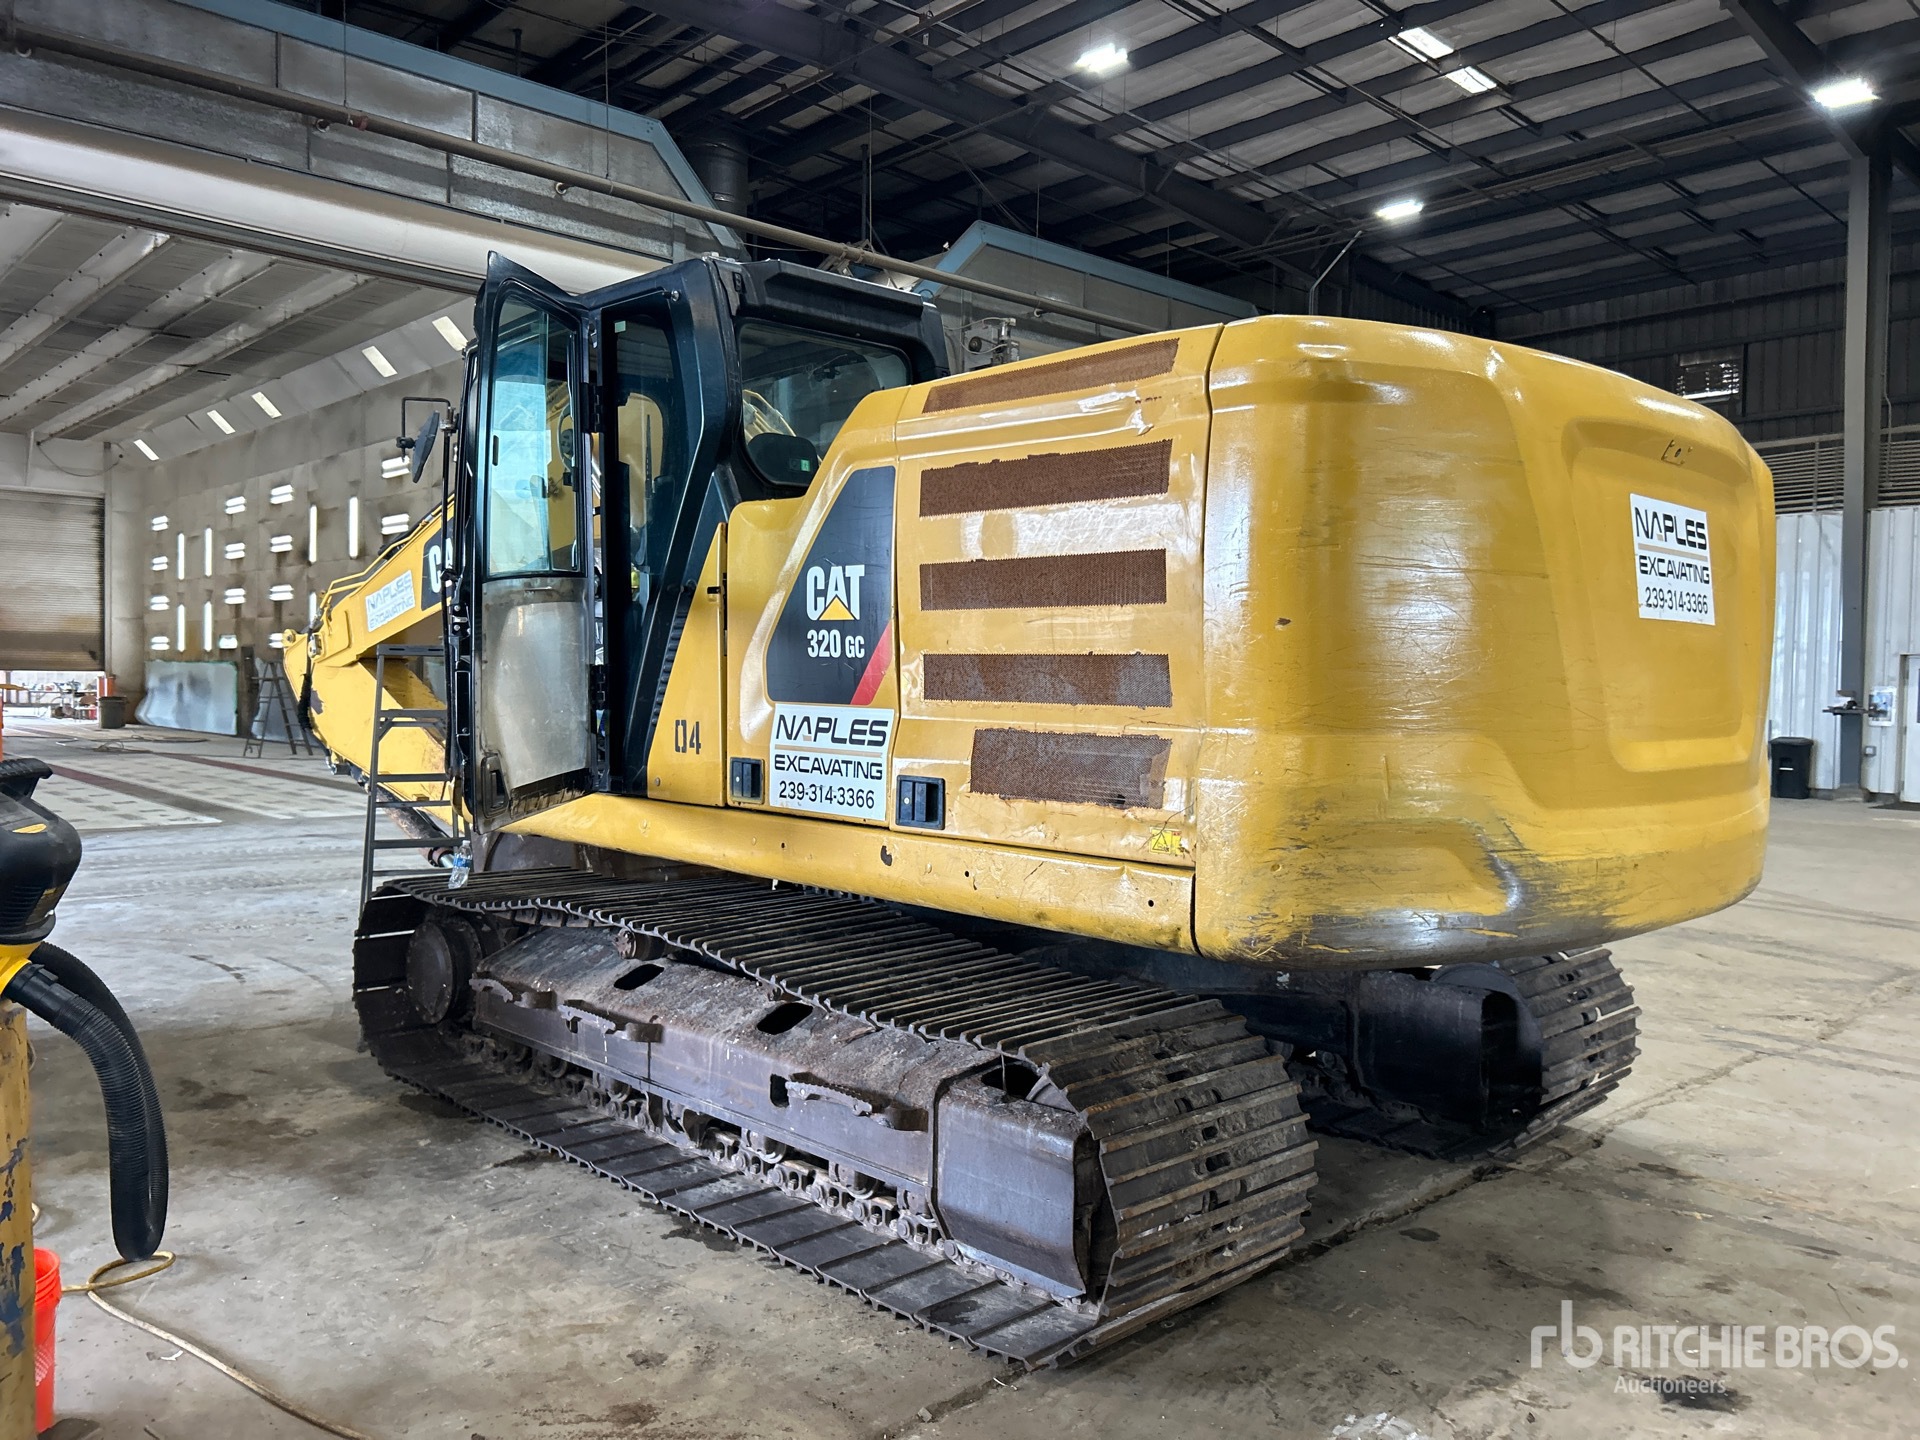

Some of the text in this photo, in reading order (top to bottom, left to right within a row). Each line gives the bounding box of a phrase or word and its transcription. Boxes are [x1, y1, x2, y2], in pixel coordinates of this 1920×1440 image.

[1634, 507, 1707, 550] NAPLES
[1638, 555, 1710, 585] EXCAVATING
[369, 574, 412, 610] NAPLES
[806, 564, 865, 621] CAT
[1645, 586, 1709, 615] 239-314-3366
[369, 596, 413, 628] EXCAVATING
[807, 629, 865, 659] 320 GC
[674, 719, 702, 755] 04
[775, 714, 889, 747] NAPLES
[774, 753, 883, 781] EXCAVATING
[779, 780, 875, 809] 239-314-3366
